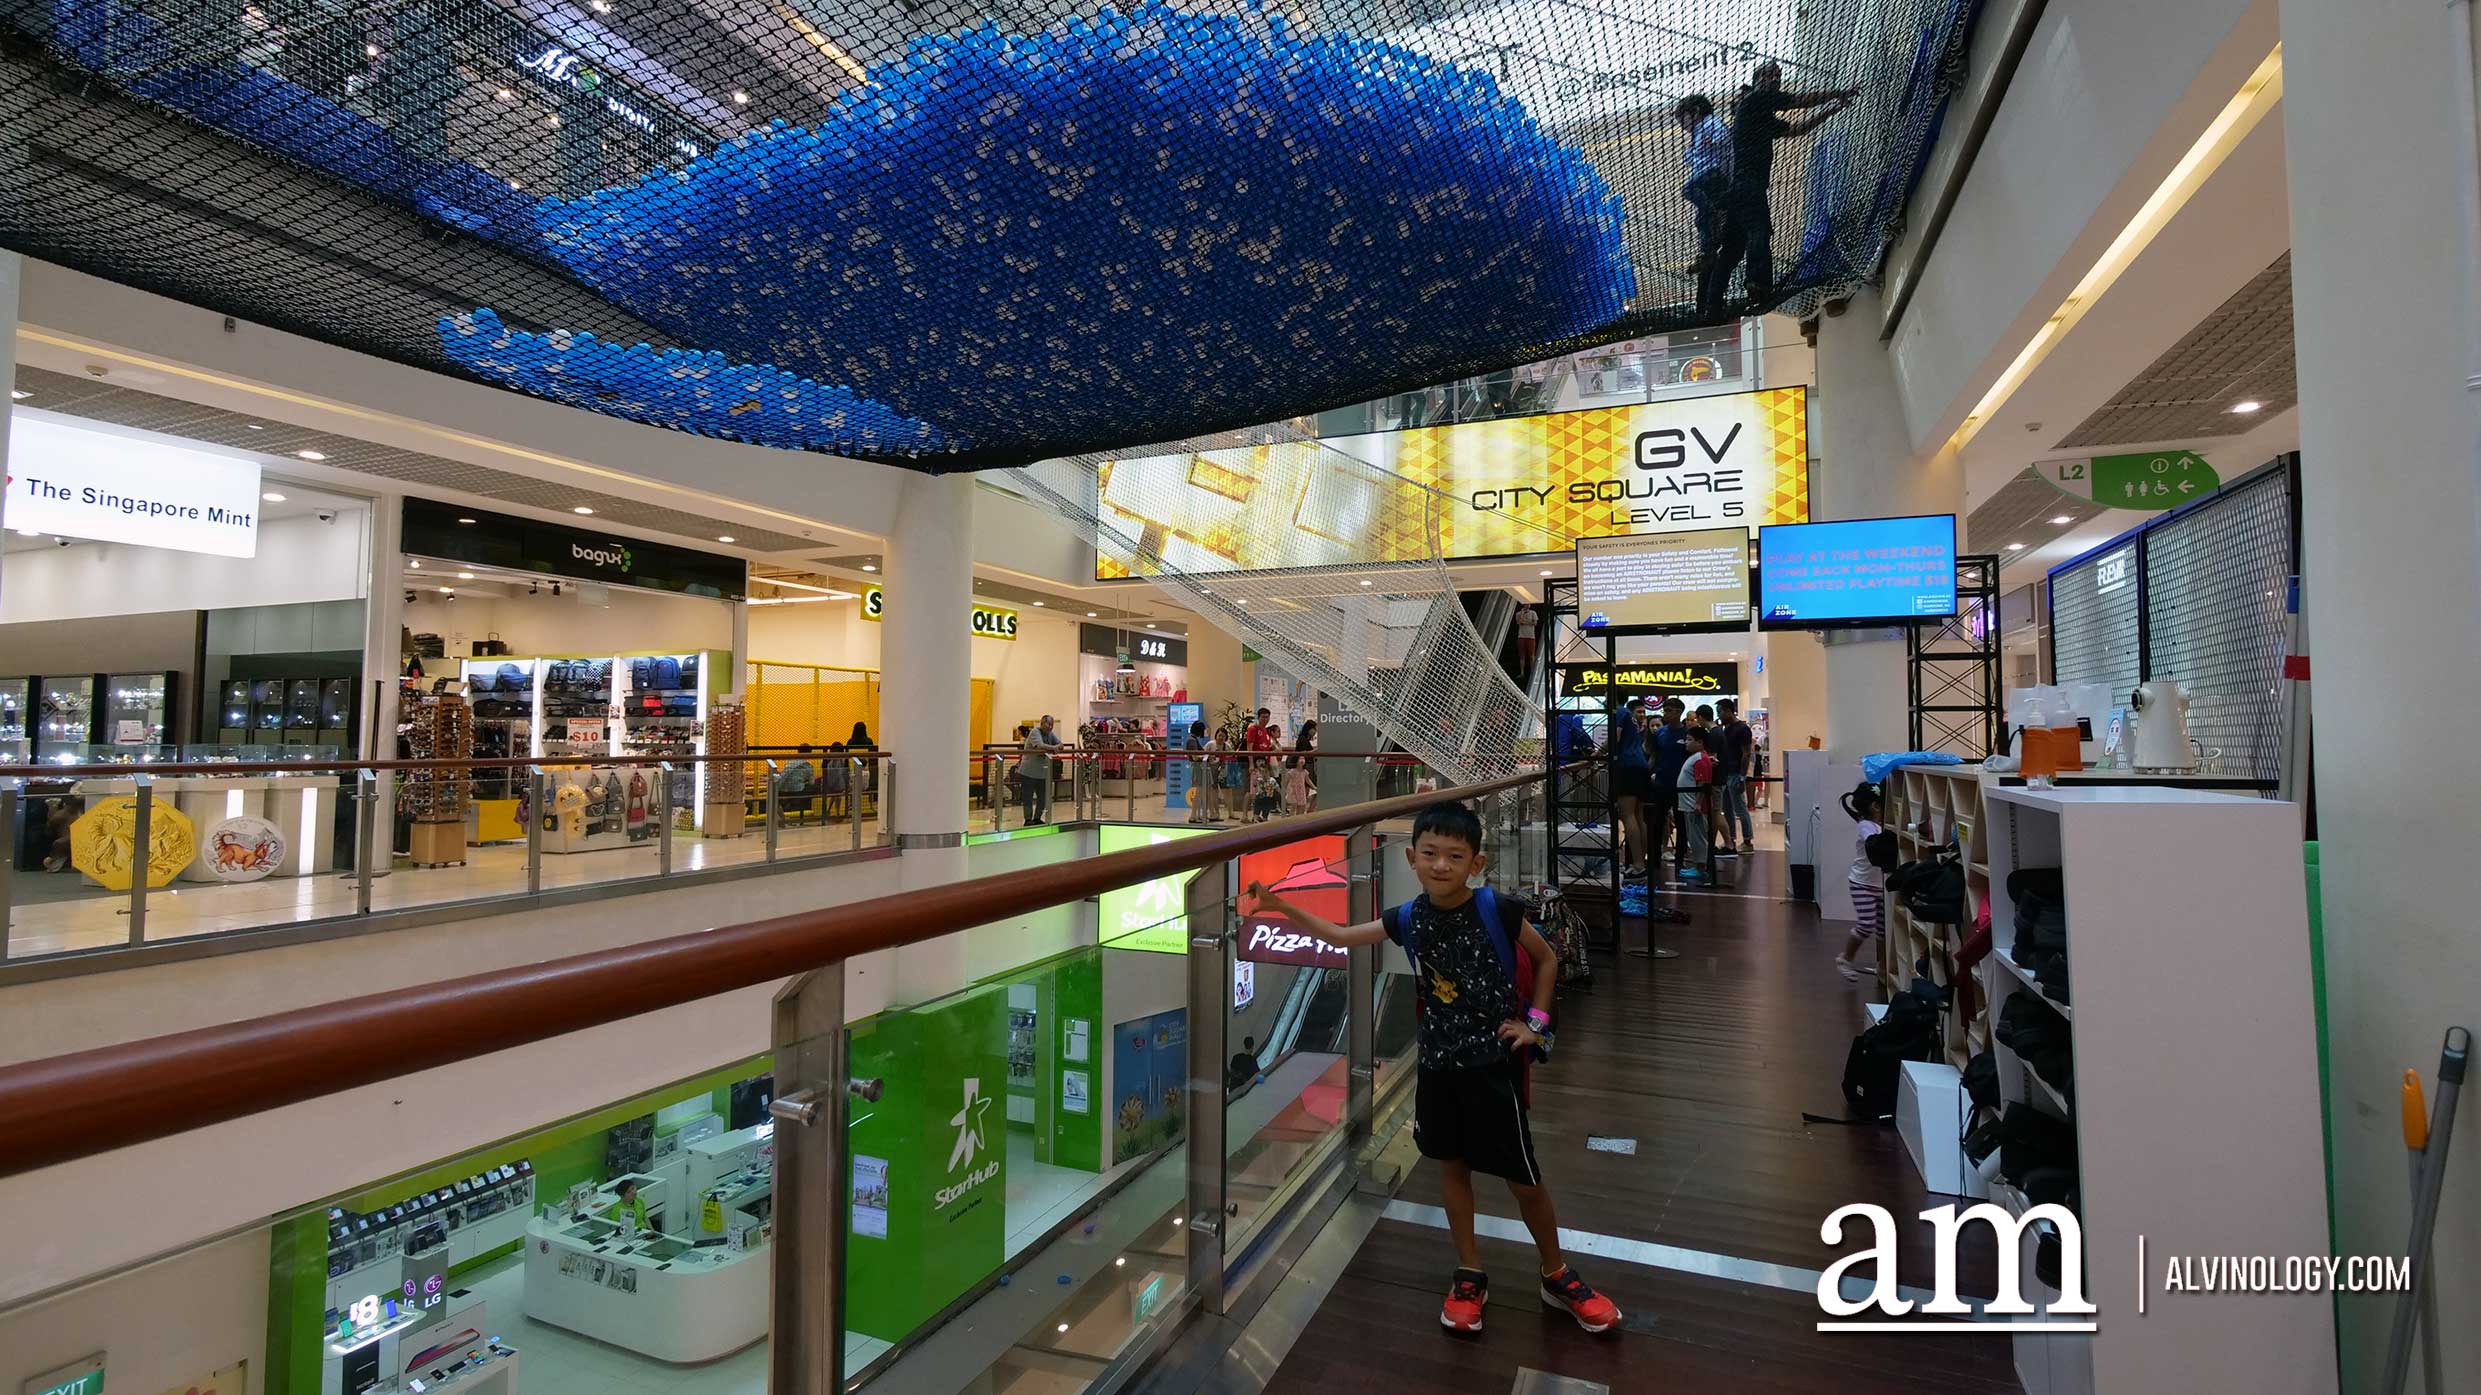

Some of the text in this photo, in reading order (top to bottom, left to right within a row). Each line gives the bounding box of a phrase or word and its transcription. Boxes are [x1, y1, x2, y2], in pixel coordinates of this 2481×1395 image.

[1635, 423, 1742, 470] GV
[2059, 464, 2085, 481] L2
[1472, 469, 1743, 511] CITY SQUARE
[27, 478, 251, 528] The Singapore Mint
[1611, 502, 1744, 525] LEVEL 5
[1809, 551, 1824, 562] AT
[1865, 544, 1944, 559] WEEKEND
[573, 731, 599, 742] $10
[1120, 911, 1188, 931] StarHu
[1249, 924, 1313, 953] Pizza
[934, 1160, 1000, 1211] StarHub
[424, 1293, 442, 1308] LG
